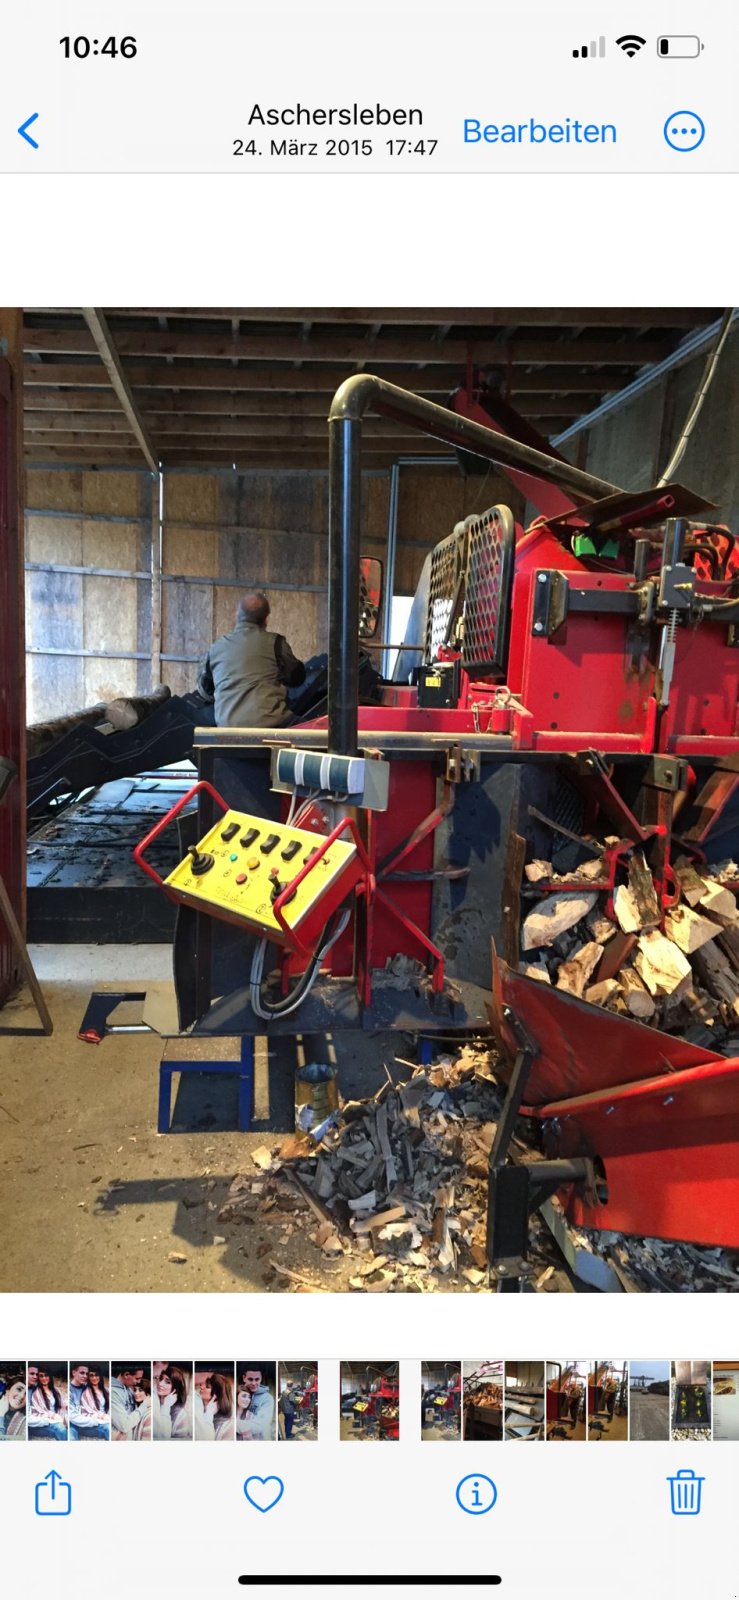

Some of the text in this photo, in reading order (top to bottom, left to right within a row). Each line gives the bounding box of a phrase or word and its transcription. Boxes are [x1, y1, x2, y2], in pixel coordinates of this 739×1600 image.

[59, 36, 138, 60] 10:46
[247, 102, 423, 126] Aschersleben
[463, 117, 617, 144] Bearbeiten
[232, 138, 439, 156] 24. März 2015 17:47
